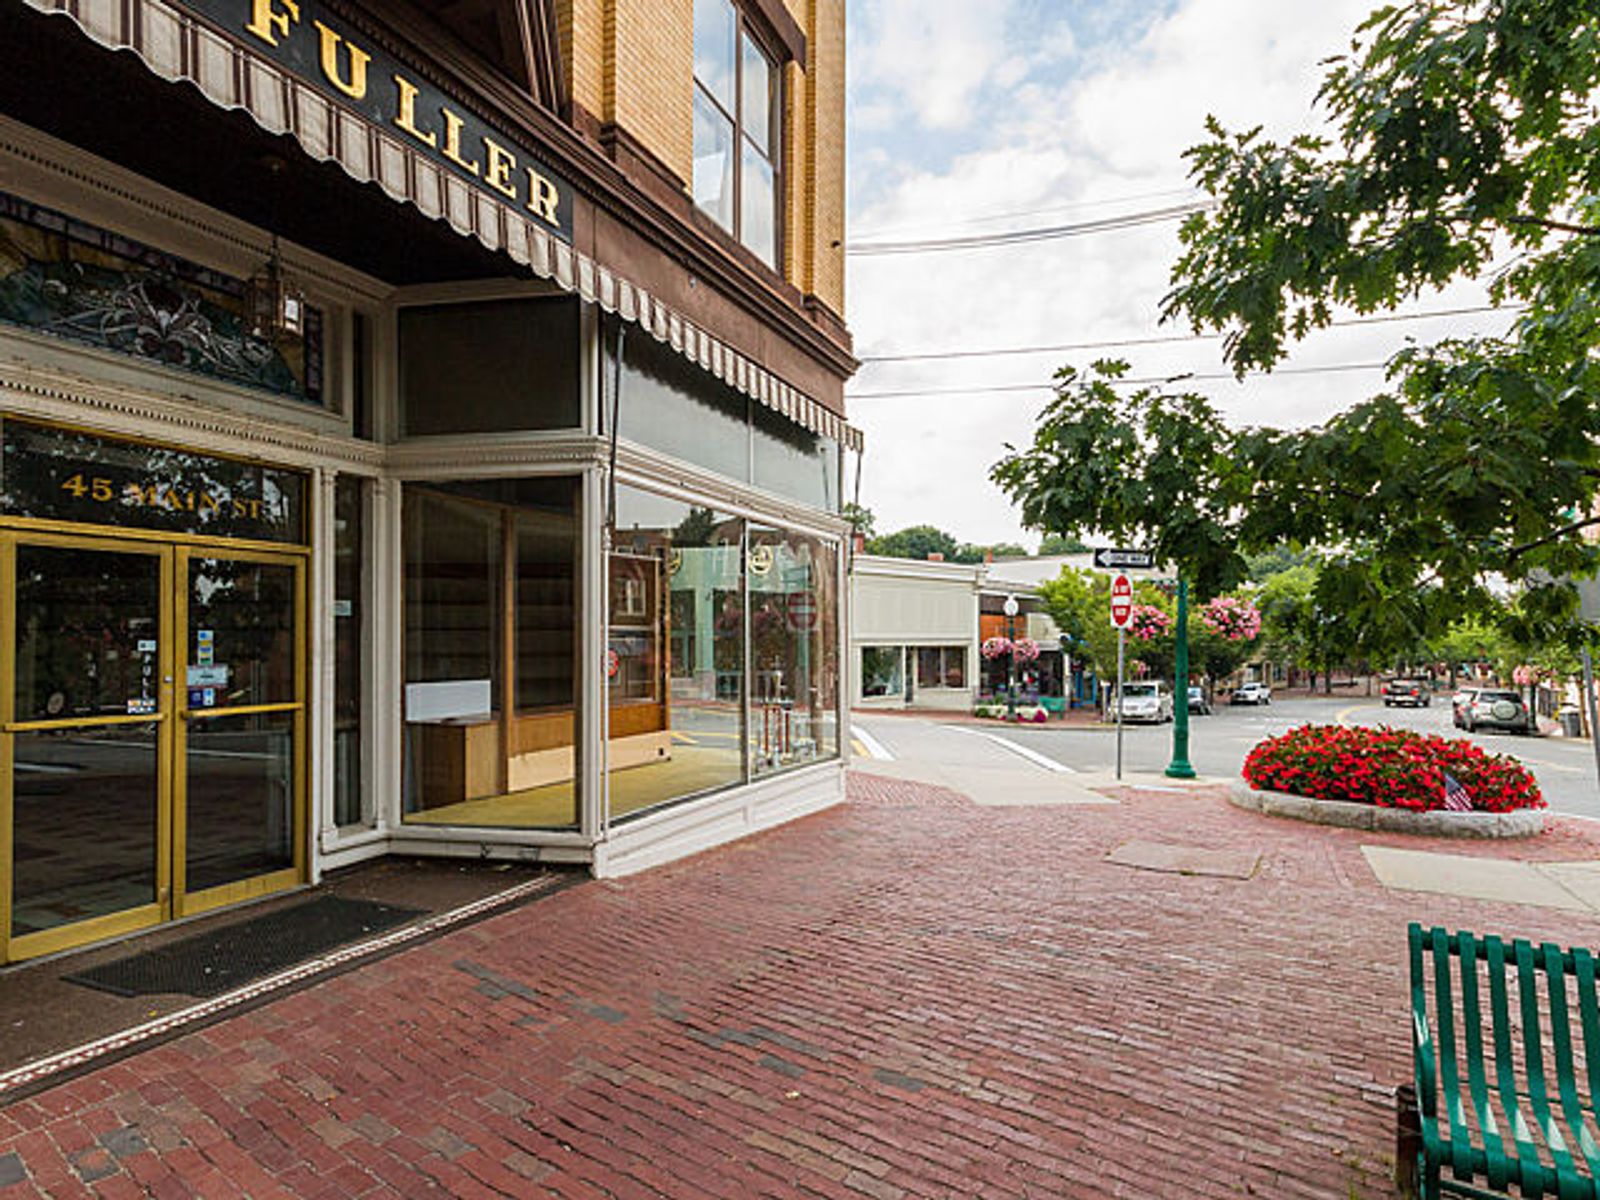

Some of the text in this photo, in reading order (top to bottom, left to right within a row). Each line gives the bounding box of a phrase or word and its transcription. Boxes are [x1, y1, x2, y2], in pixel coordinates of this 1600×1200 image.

[246, 0, 560, 228] FULLER
[61, 473, 264, 519] 45 MAIN ST
